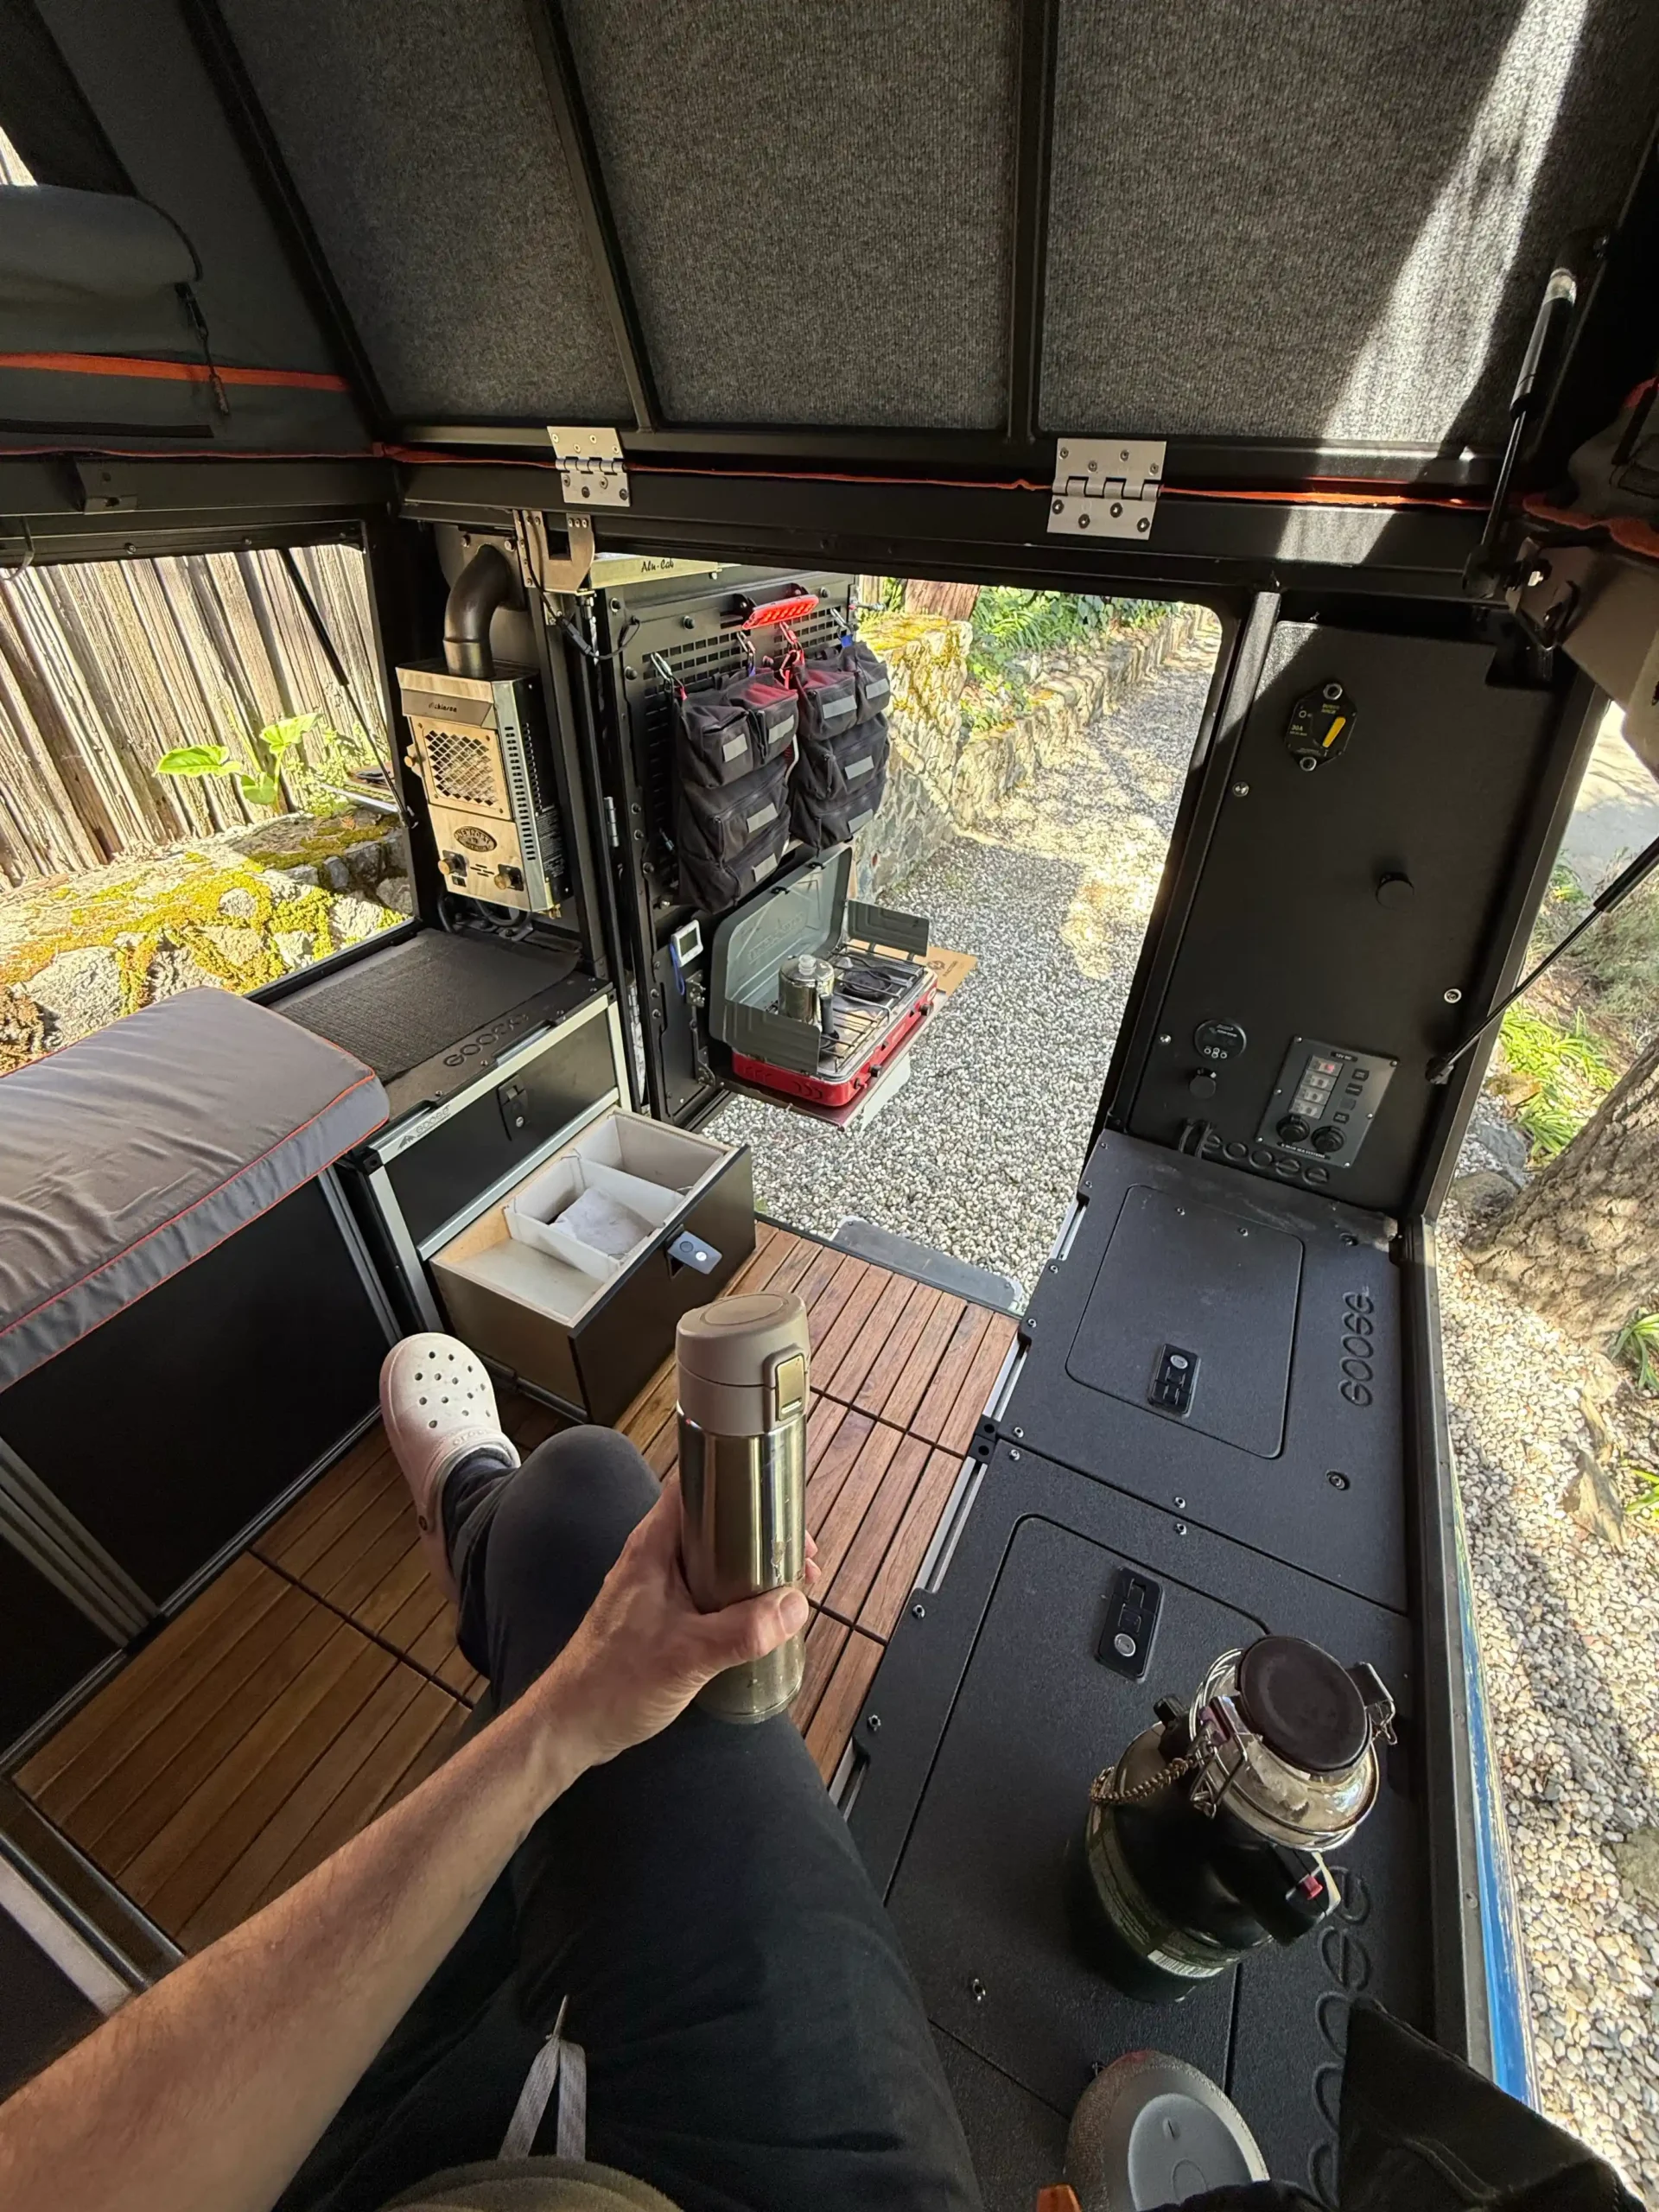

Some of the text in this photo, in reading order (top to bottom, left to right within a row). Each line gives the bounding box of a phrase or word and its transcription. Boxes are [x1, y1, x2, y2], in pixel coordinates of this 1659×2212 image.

[641, 557, 674, 573] Alu-Cab
[429, 702, 457, 713] dckinson
[1338, 1292, 1374, 1407] GOOSE
